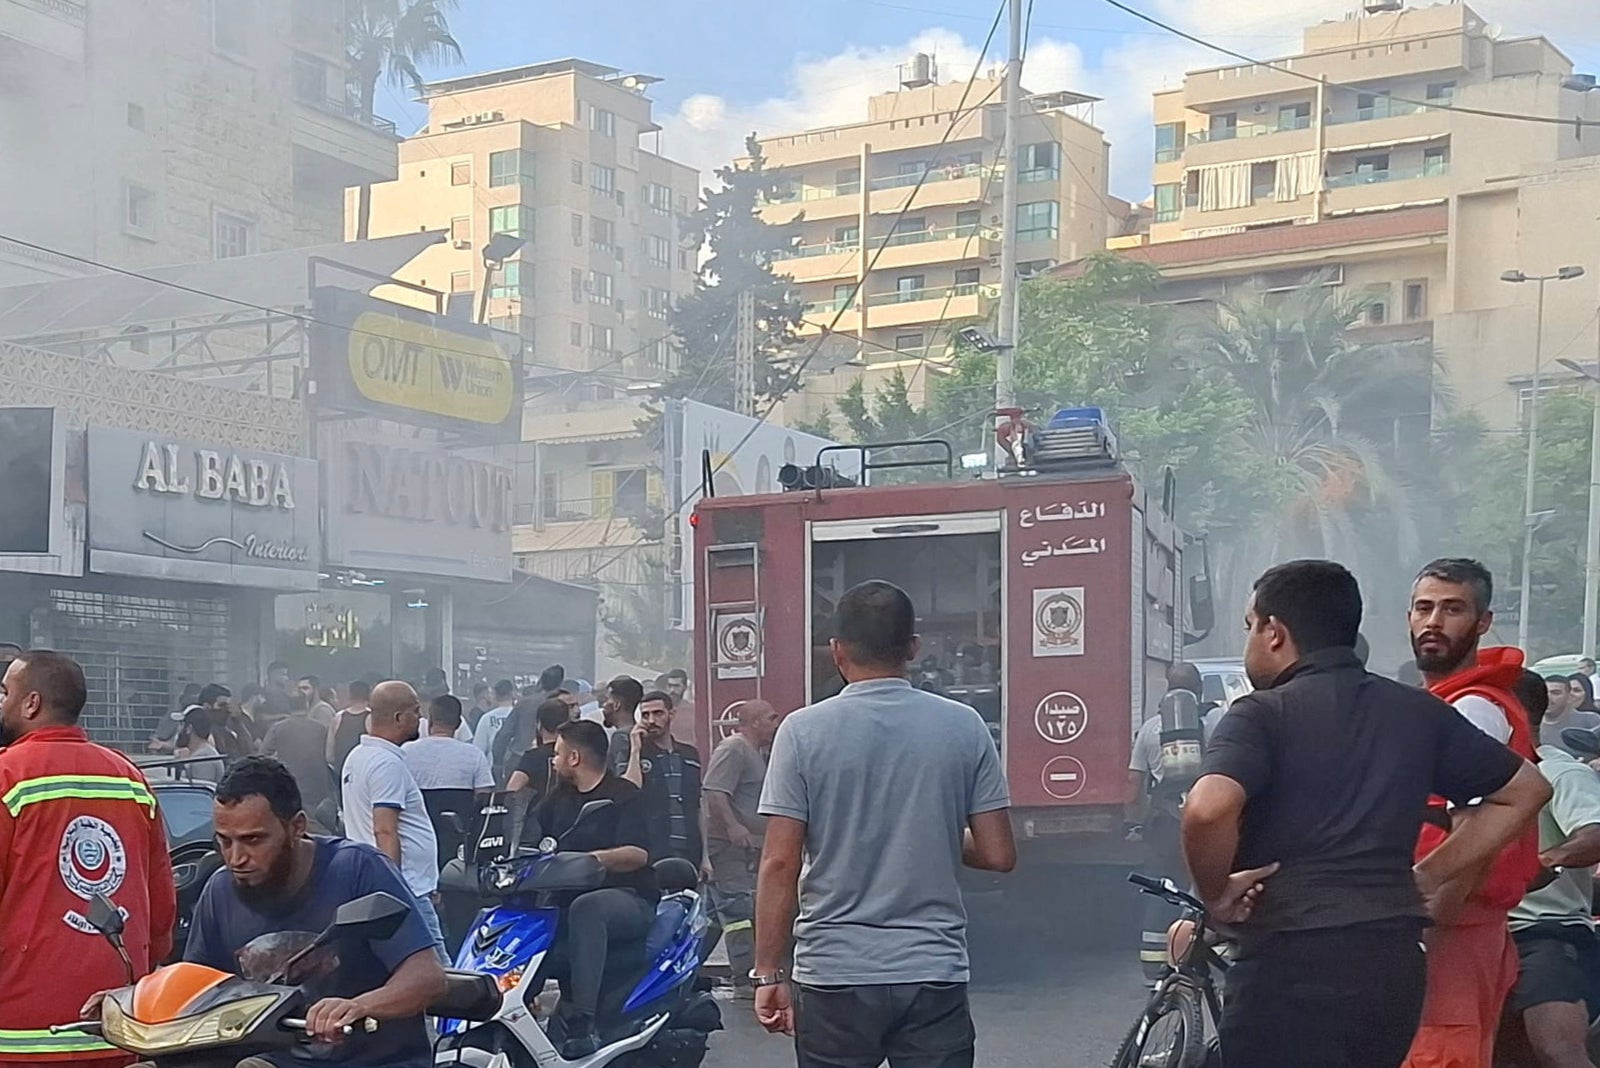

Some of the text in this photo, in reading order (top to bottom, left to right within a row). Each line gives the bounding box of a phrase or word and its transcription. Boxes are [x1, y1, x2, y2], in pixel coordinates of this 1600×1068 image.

[361, 337, 424, 386] OMT
[134, 440, 296, 510] AL BABA
[1044, 702, 1080, 719] صيدا
[1046, 720, 1077, 736] ١٢٥
